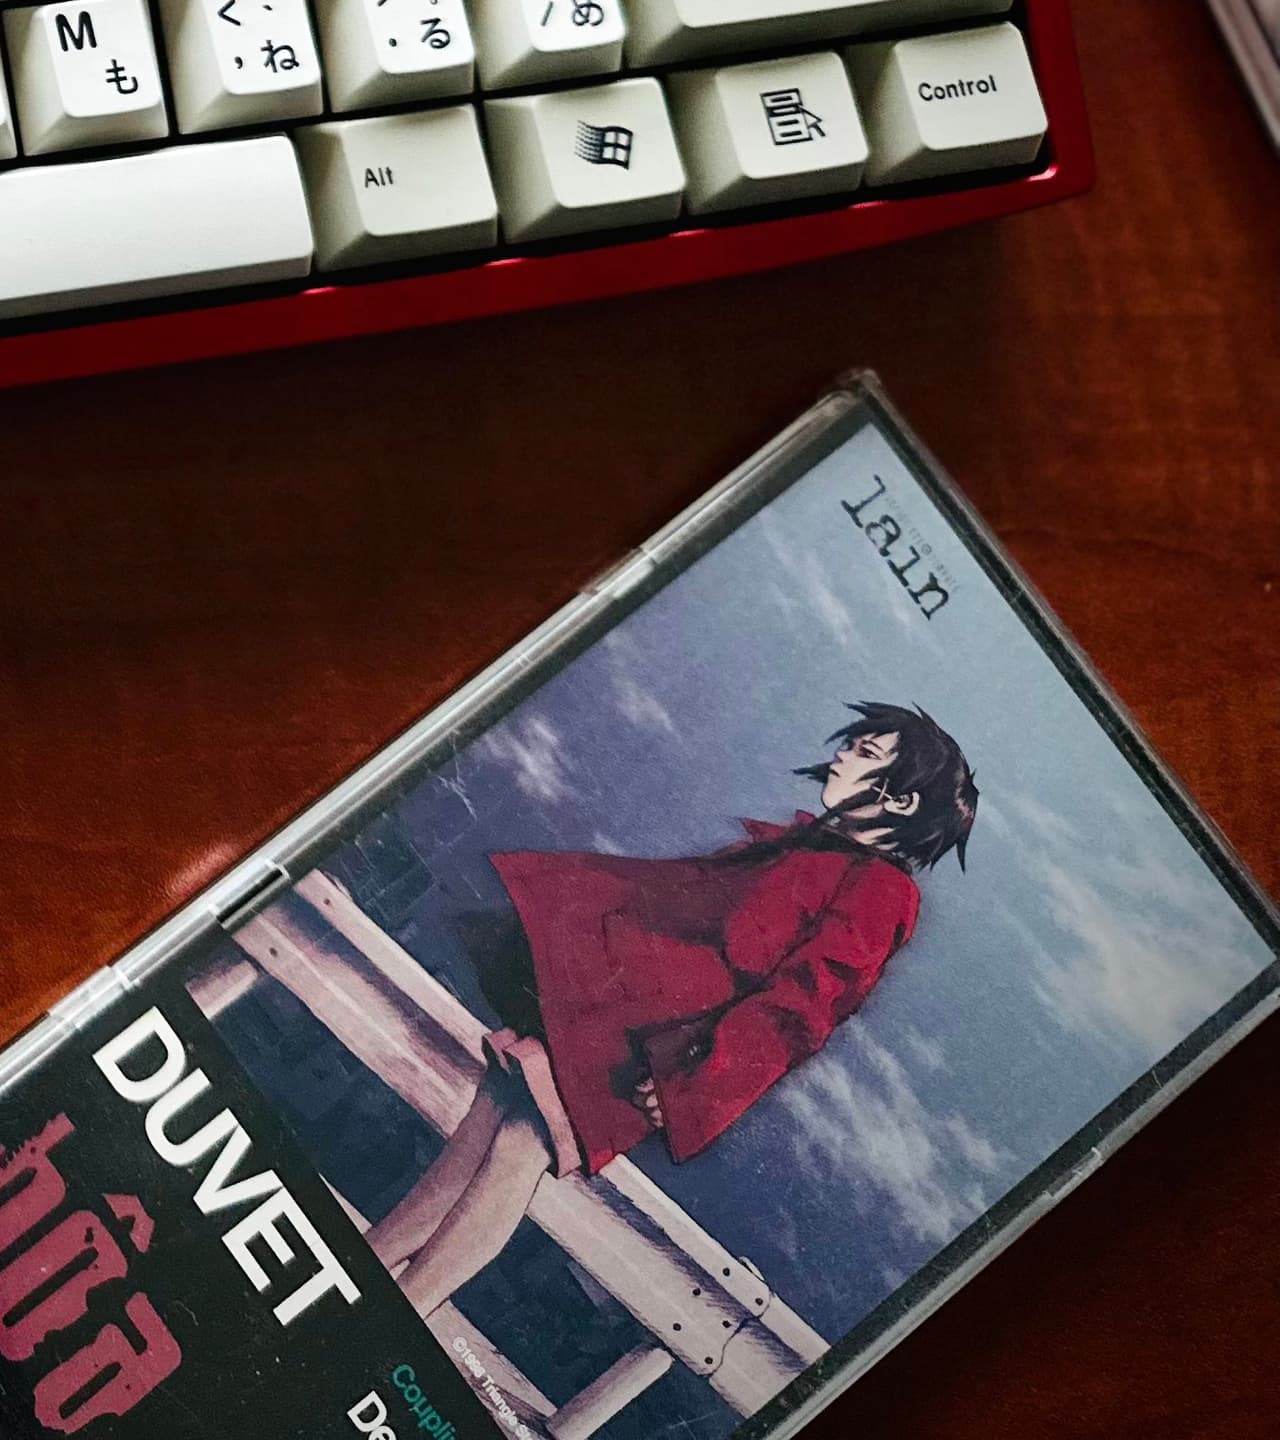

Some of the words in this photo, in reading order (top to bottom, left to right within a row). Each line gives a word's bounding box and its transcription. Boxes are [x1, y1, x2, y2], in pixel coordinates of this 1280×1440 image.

[55, 10, 98, 52] M
[420, 17, 451, 50] る
[260, 39, 300, 74] ね
[105, 58, 139, 95] も
[918, 74, 998, 102] Control
[364, 166, 394, 189] Alt
[840, 474, 949, 620] lain
[92, 1006, 361, 1327] DUVET
[392, 1364, 459, 1440] Coupli
[481, 1374, 520, 1433] Triangle
